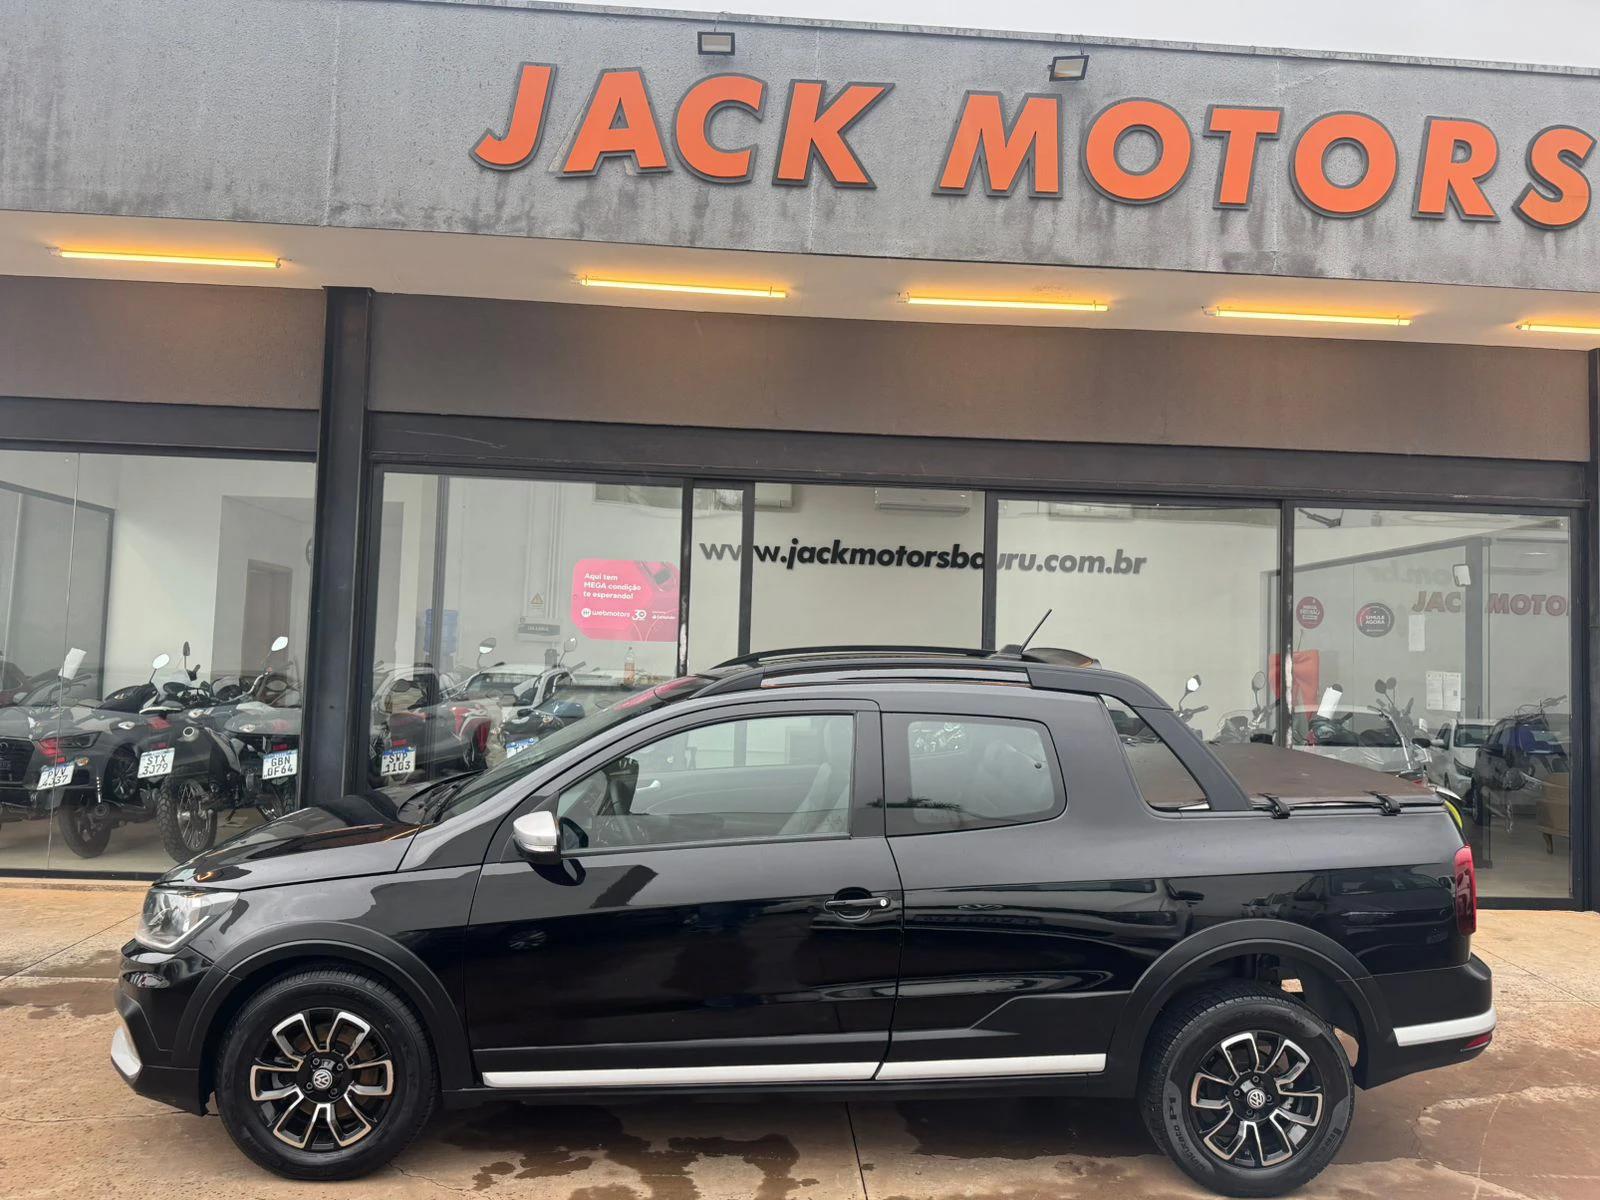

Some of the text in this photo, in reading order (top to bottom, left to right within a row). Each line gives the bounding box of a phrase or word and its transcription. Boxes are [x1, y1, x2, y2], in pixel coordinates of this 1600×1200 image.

[469, 62, 1597, 231] JACK MOTORS
[584, 573, 618, 581] Aqui tem
[584, 581, 642, 591] MEGA condição
[1411, 590, 1569, 616] JAC MOTO
[591, 609, 630, 618] webmotors
[147, 754, 167, 765] STX
[271, 756, 291, 767] GBN
[388, 752, 408, 763] SWP
[142, 763, 168, 775] 3J79
